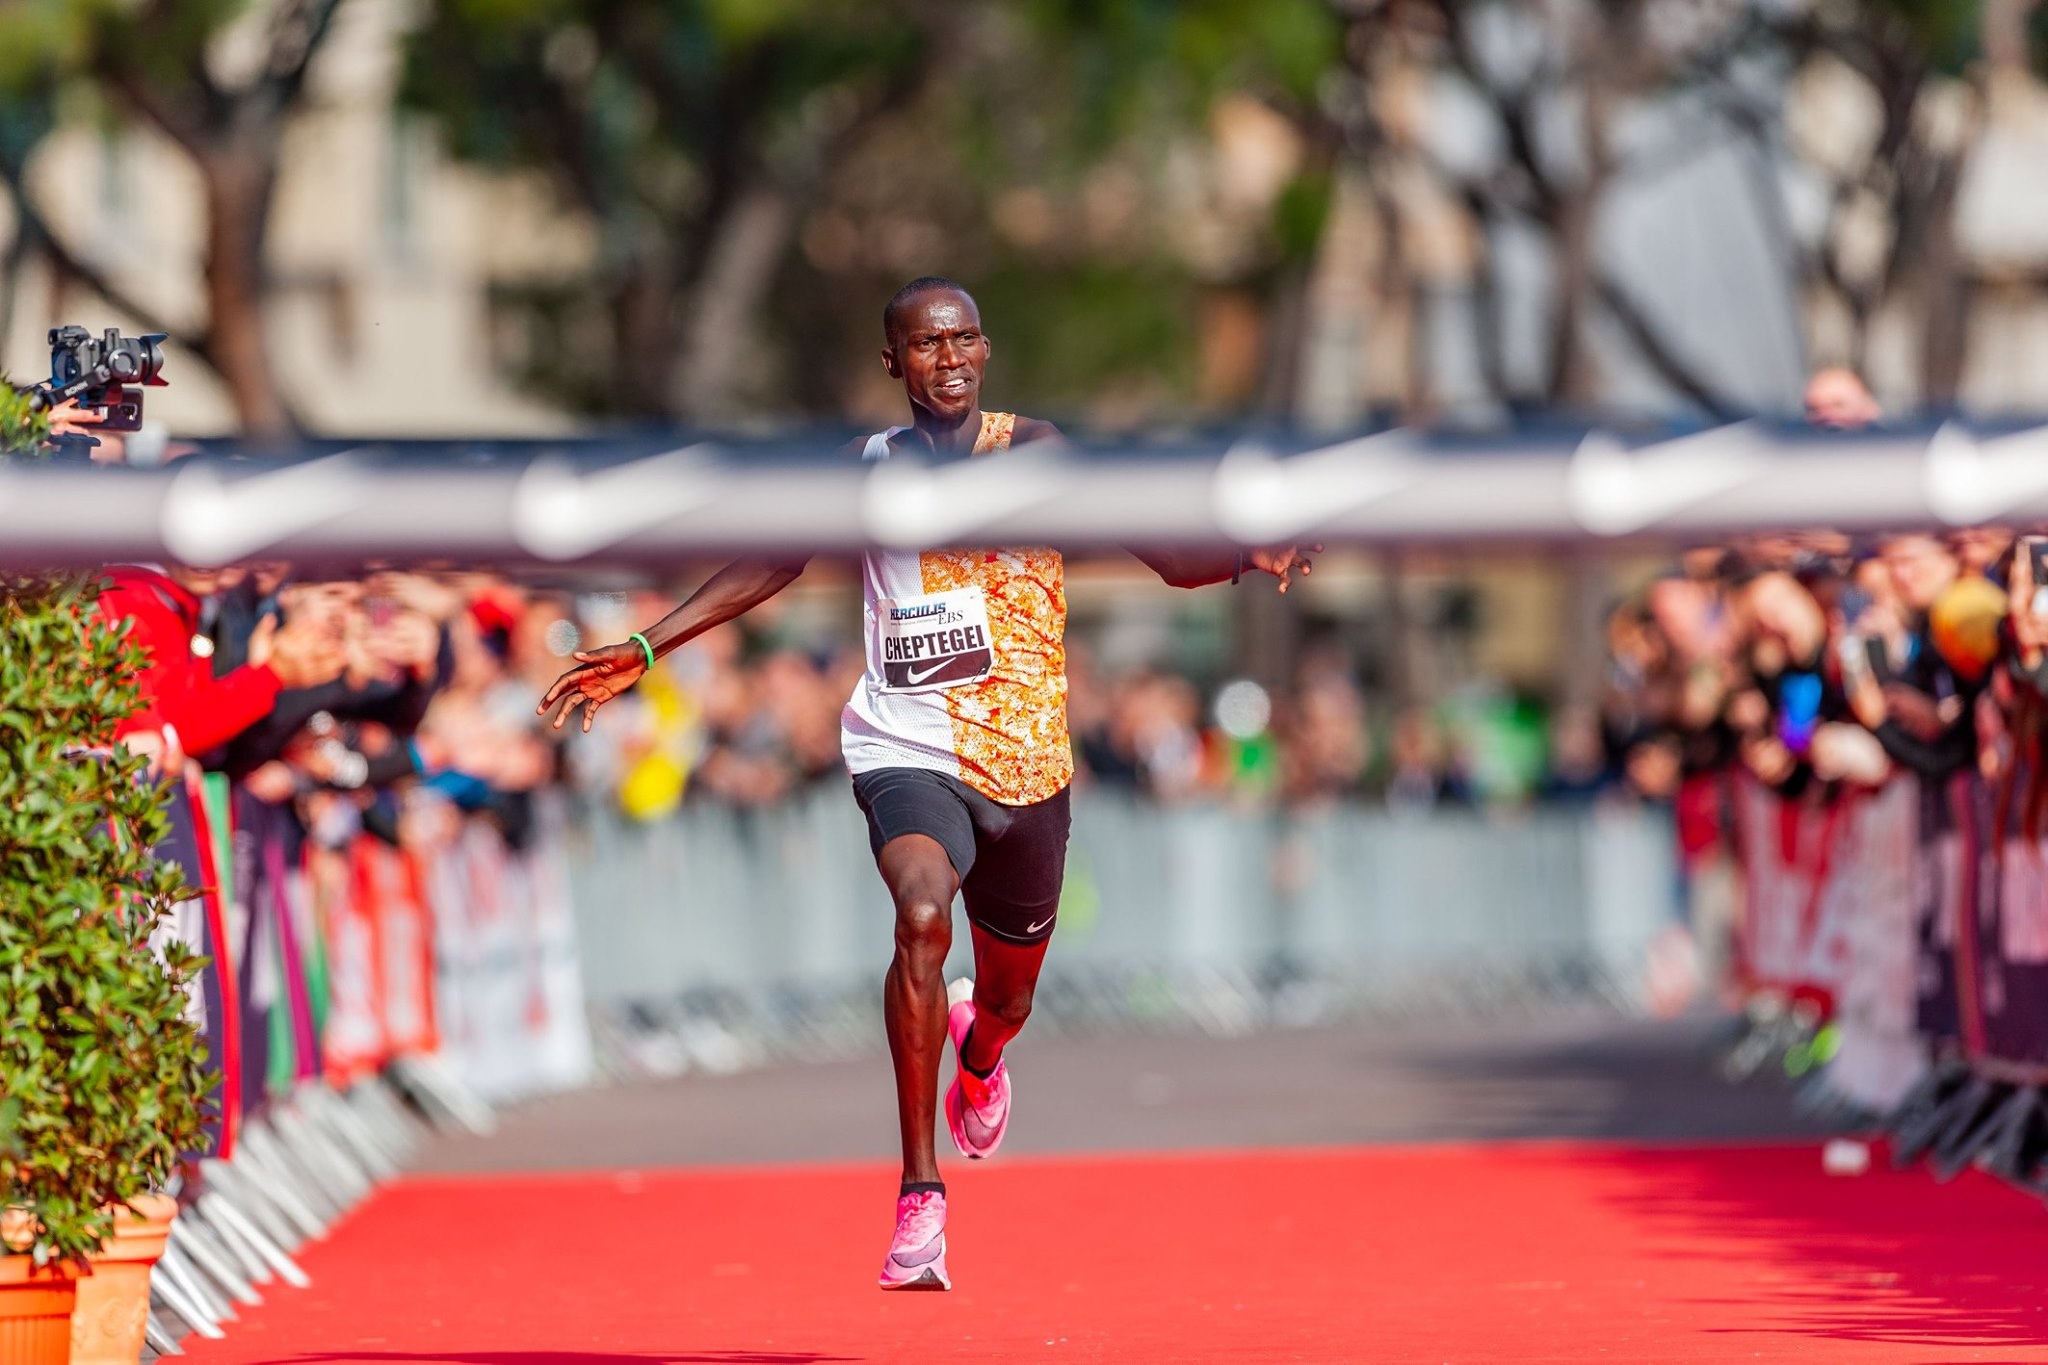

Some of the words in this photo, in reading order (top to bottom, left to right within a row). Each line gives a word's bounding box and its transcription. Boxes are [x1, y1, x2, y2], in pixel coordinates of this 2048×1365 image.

[890, 602, 946, 620] HERCULIS
[938, 610, 964, 625] EBS
[885, 625, 985, 660] CHEPTEGEI
